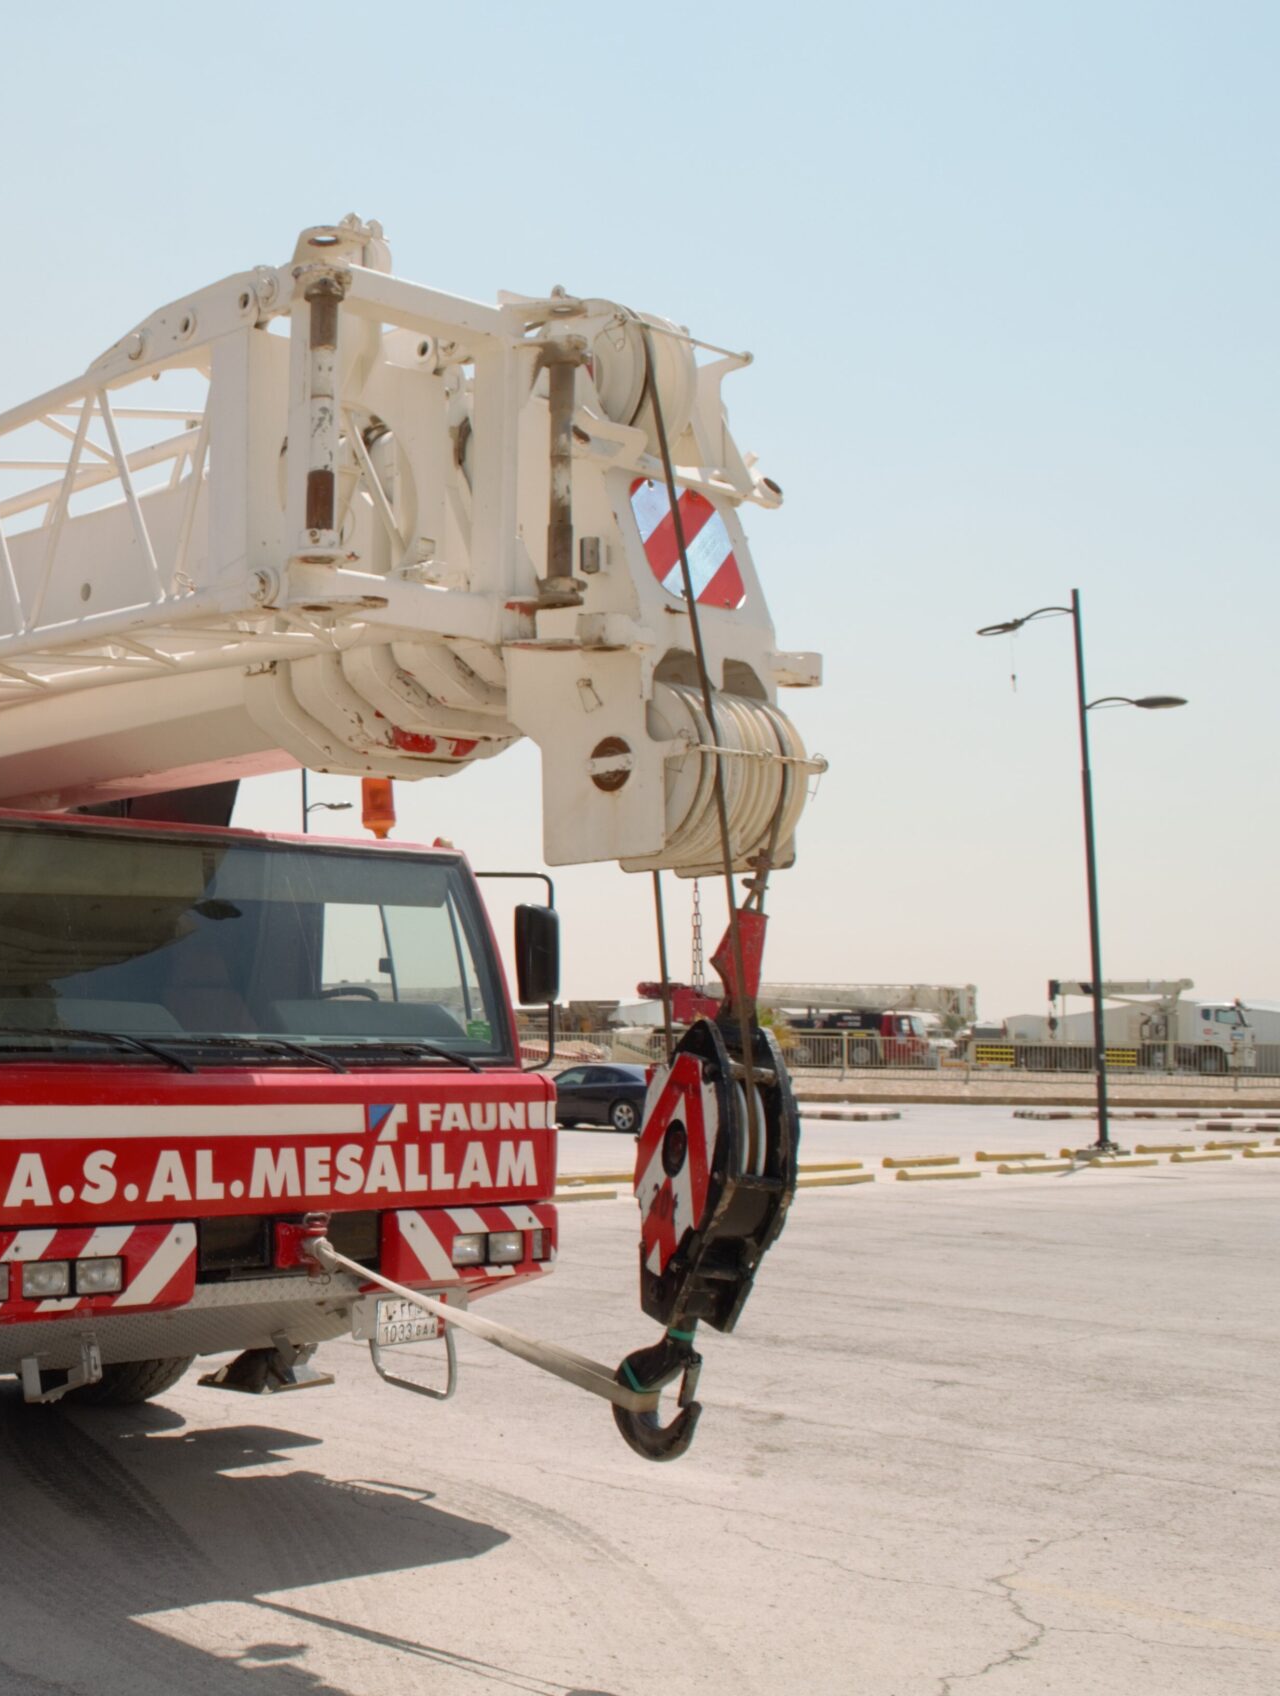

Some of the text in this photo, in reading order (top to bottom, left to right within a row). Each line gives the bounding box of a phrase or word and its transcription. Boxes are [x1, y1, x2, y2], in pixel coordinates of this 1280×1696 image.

[419, 1102, 526, 1132] FAUN
[4, 1141, 538, 1207] A.S.AL.MESALLAM
[384, 1322, 413, 1343] 1033
